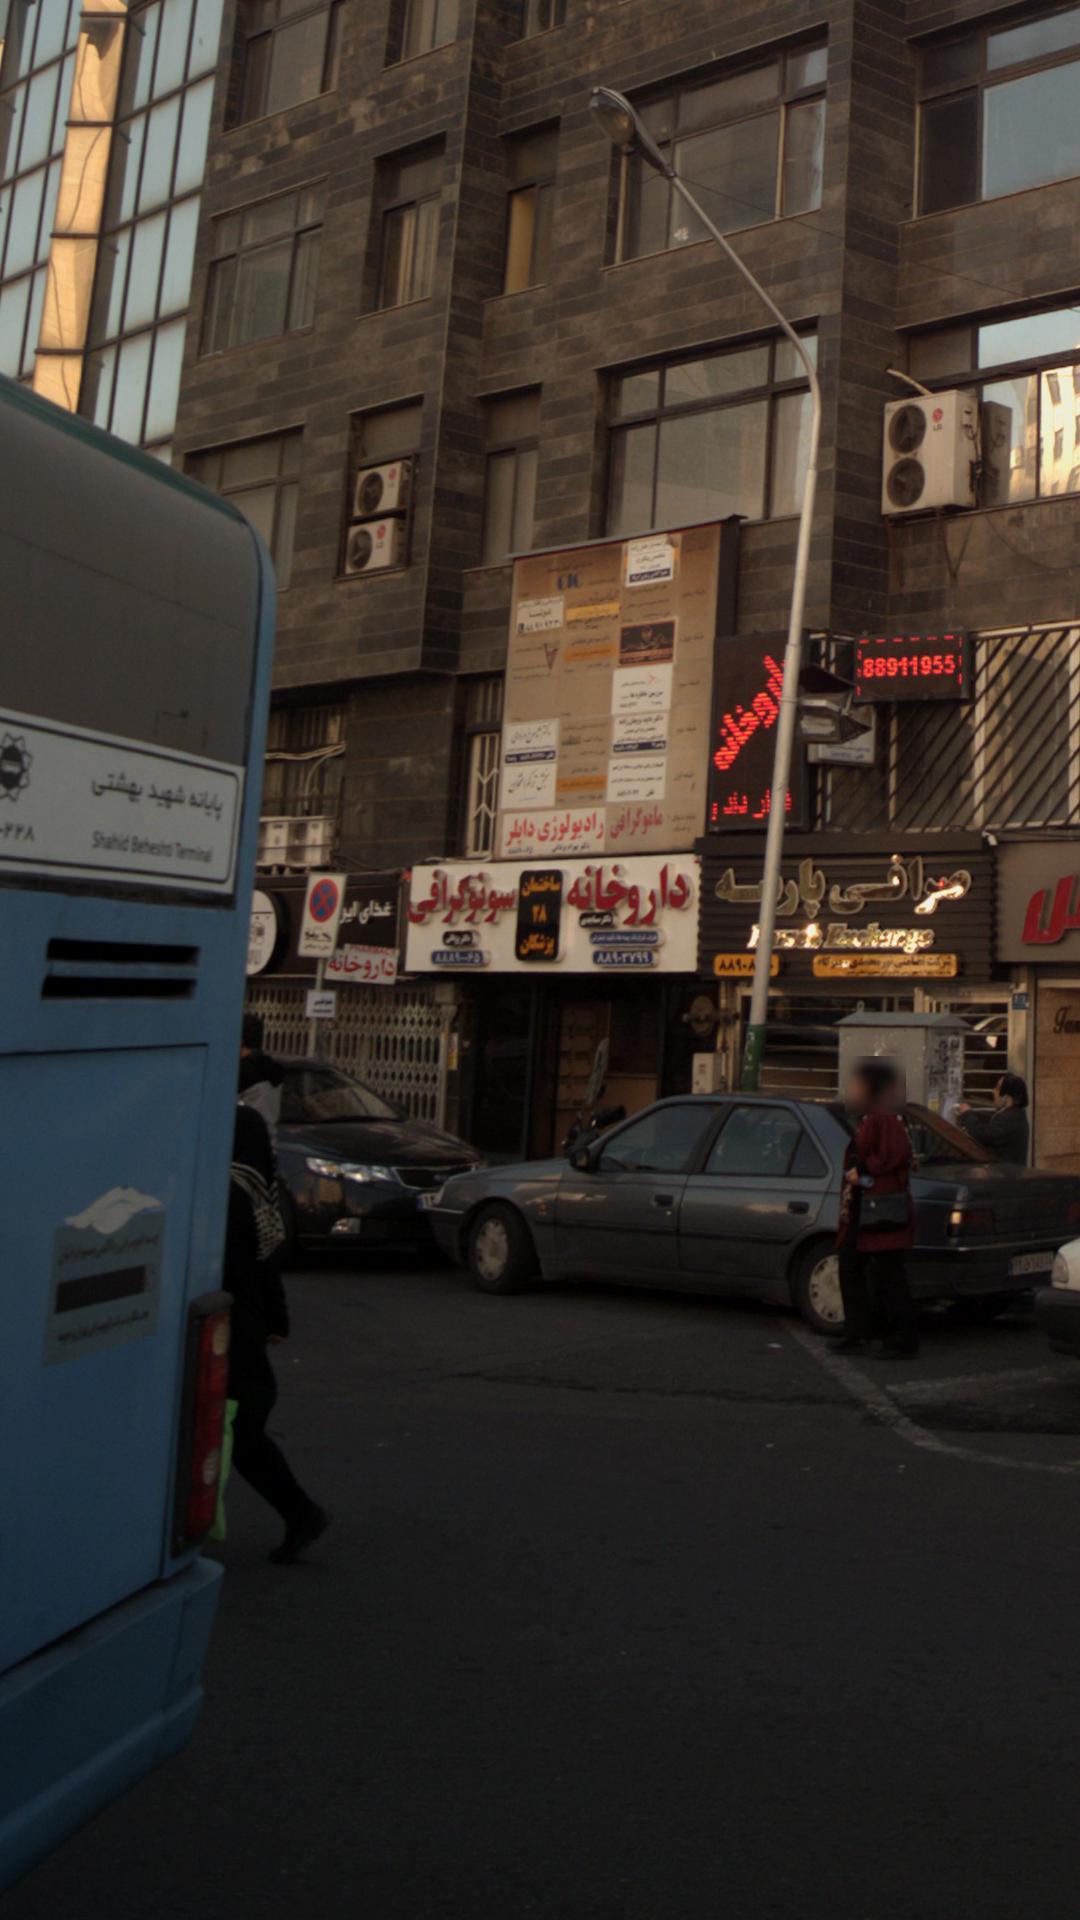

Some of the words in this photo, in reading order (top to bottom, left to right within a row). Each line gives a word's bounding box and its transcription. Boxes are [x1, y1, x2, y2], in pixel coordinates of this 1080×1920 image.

[862, 654, 957, 679] 88911955
[91, 771, 144, 803] بهشتی
[147, 783, 186, 809] شهید
[188, 790, 224, 822] پایانه
[609, 804, 664, 839] ماموگرافی
[537, 810, 605, 843] رادیولوژی
[92, 830, 130, 852] Shahid
[131, 835, 173, 858] Beheshti
[176, 842, 213, 863] Terminal
[406, 870, 517, 924] سونوگرافی
[521, 874, 561, 897] ساختمان
[566, 864, 691, 925] داروخانه
[829, 852, 973, 915] صرافی
[358, 900, 393, 925] غذای
[519, 931, 556, 955] پزشکان
[823, 922, 935, 953] Exchange
[328, 954, 396, 981] داروخانه
